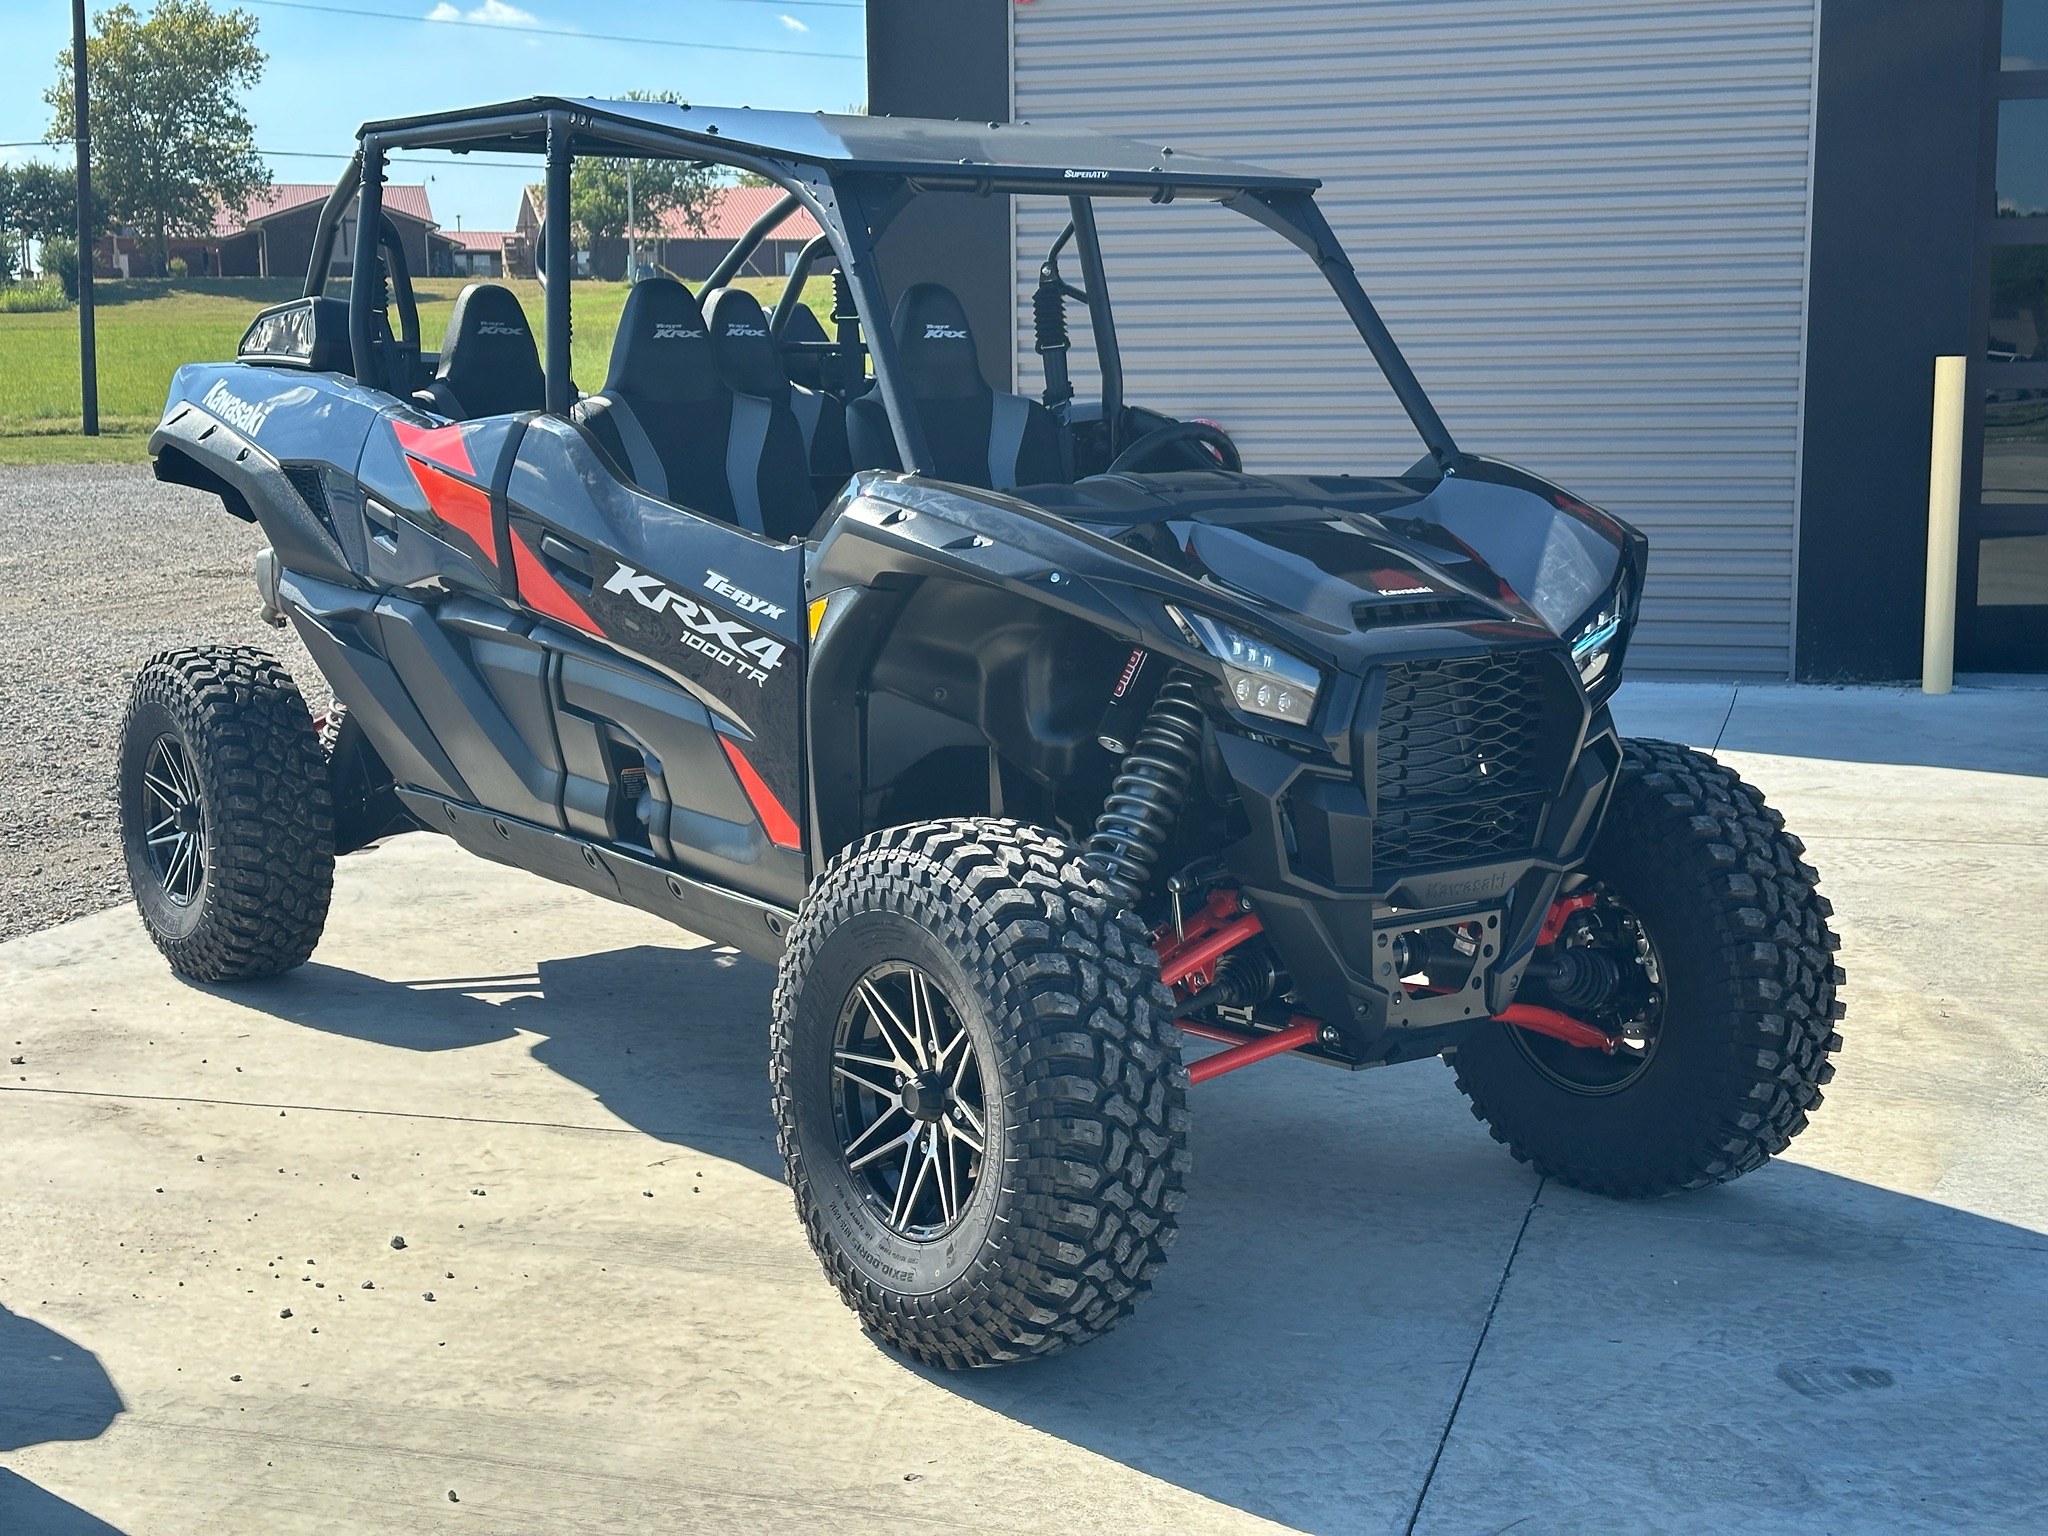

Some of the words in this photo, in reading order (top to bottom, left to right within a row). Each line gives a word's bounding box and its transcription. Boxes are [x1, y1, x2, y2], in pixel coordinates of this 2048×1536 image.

[477, 326, 523, 335] KRX
[653, 329, 702, 338] KRX
[725, 328, 766, 337] KRX
[923, 329, 967, 339] KRX
[201, 378, 270, 438] Kawasaki
[703, 568, 788, 620] TERYX
[1378, 586, 1434, 596] Kawasaki
[603, 561, 787, 670] KRX4
[1426, 872, 1506, 899] Kawasaki
